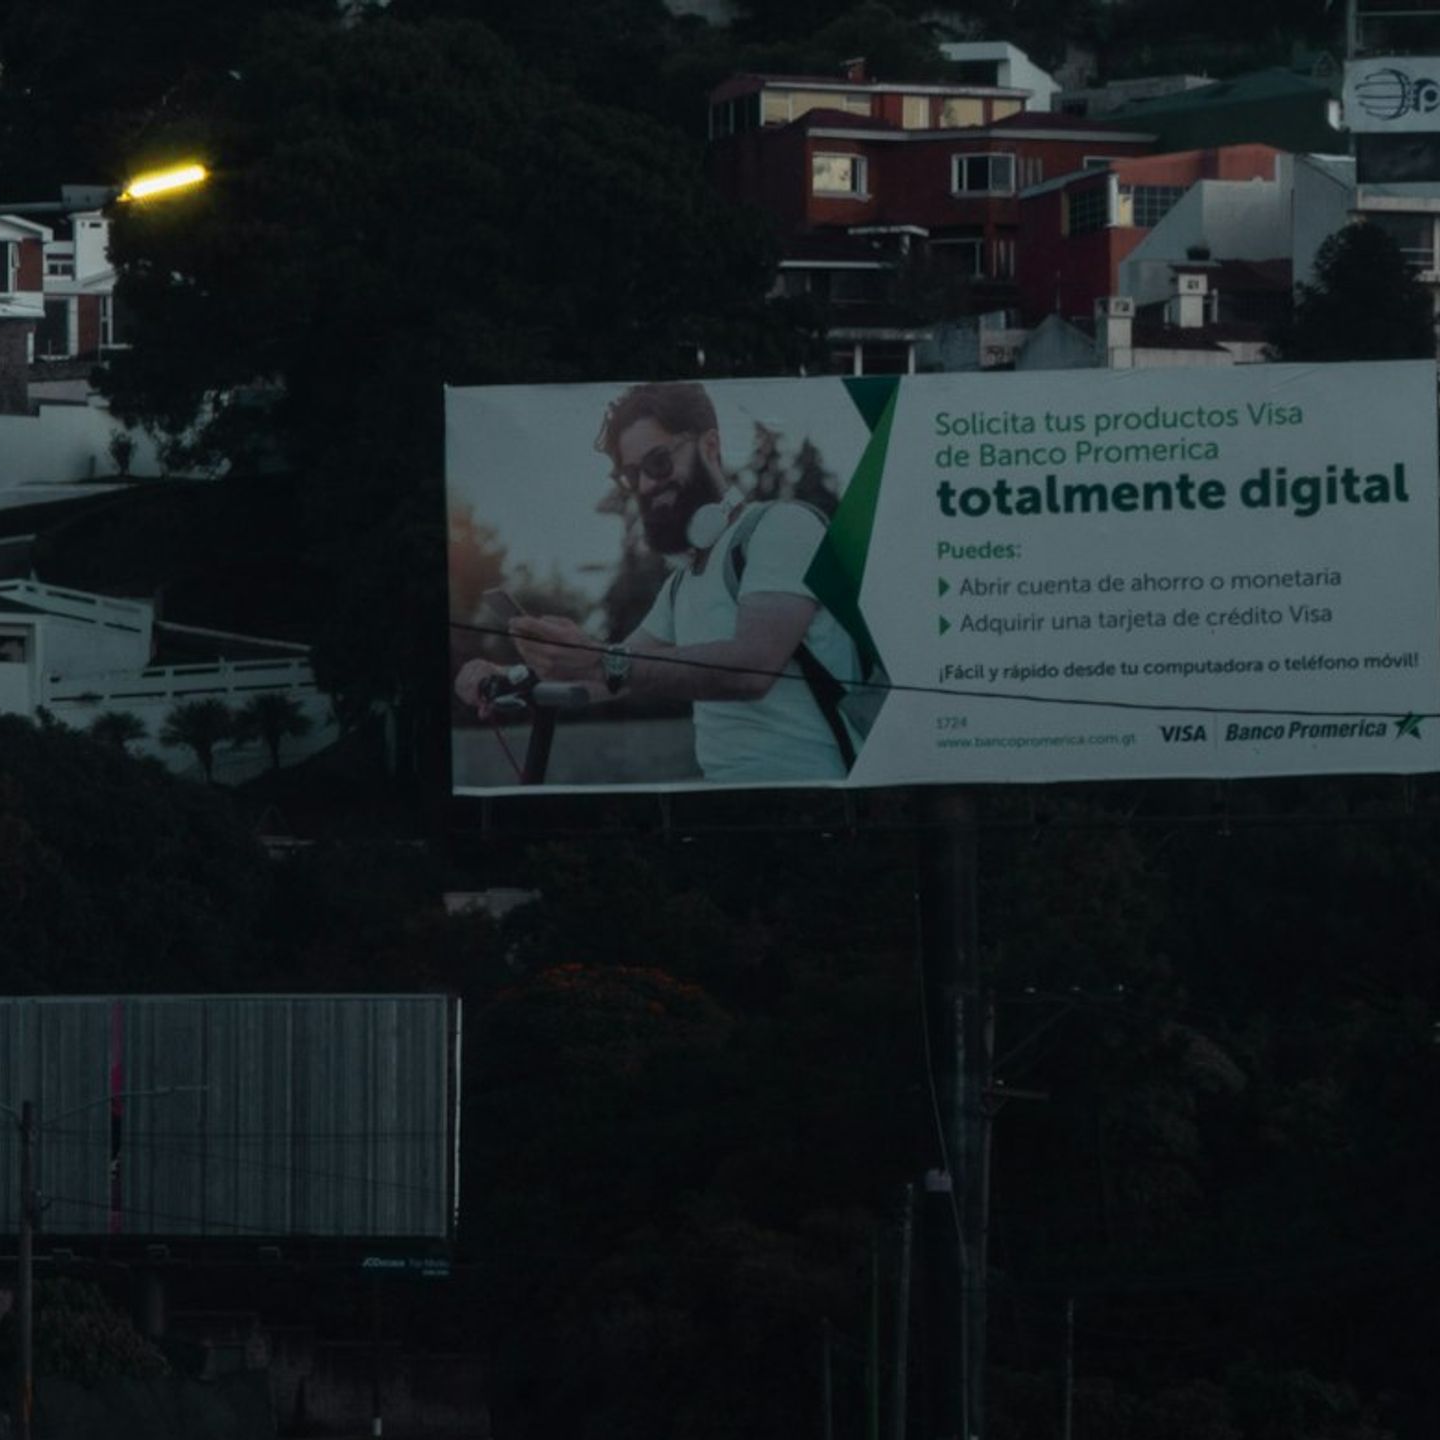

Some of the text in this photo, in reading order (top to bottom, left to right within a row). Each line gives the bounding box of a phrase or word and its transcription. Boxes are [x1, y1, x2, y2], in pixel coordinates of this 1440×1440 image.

[935, 402, 1303, 437] Solicita tus productos Visa
[935, 438, 1219, 468] de Banco Promerica
[936, 462, 1410, 517] totalmente digital
[937, 540, 1022, 561] Puedes:
[959, 567, 1342, 596] Abrir cuenta de ahorro o monetaria
[959, 604, 1333, 636] Adquirir una tarjeta de crédito Visa
[939, 652, 1420, 684] ¡Fácil y rápido desde tu computadora o teléfono móvil!
[936, 732, 1136, 749] www.bancopromerica.com.gt
[1160, 724, 1207, 742] VISA
[1225, 718, 1388, 742] Banco Promerica
